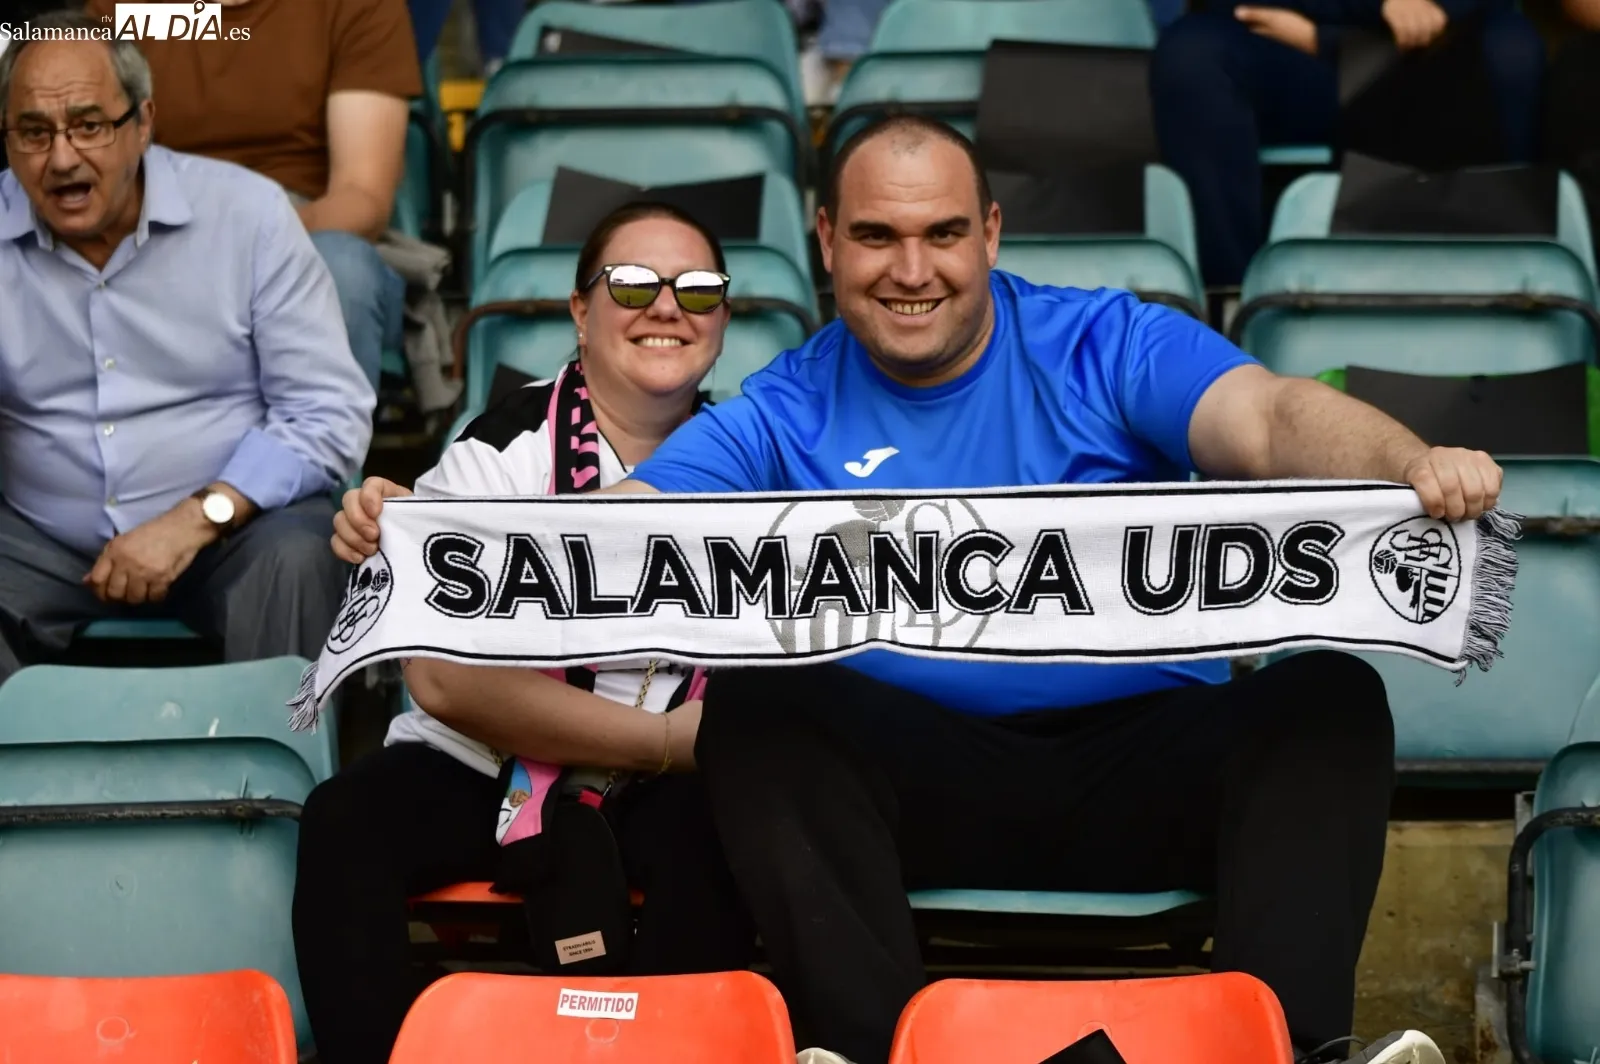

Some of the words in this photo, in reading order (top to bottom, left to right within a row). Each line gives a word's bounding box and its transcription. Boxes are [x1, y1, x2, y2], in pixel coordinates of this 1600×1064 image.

[423, 528, 1095, 619] SALAMANCA
[1121, 520, 1345, 616] UDS
[560, 993, 635, 1013] PERMITIDO
